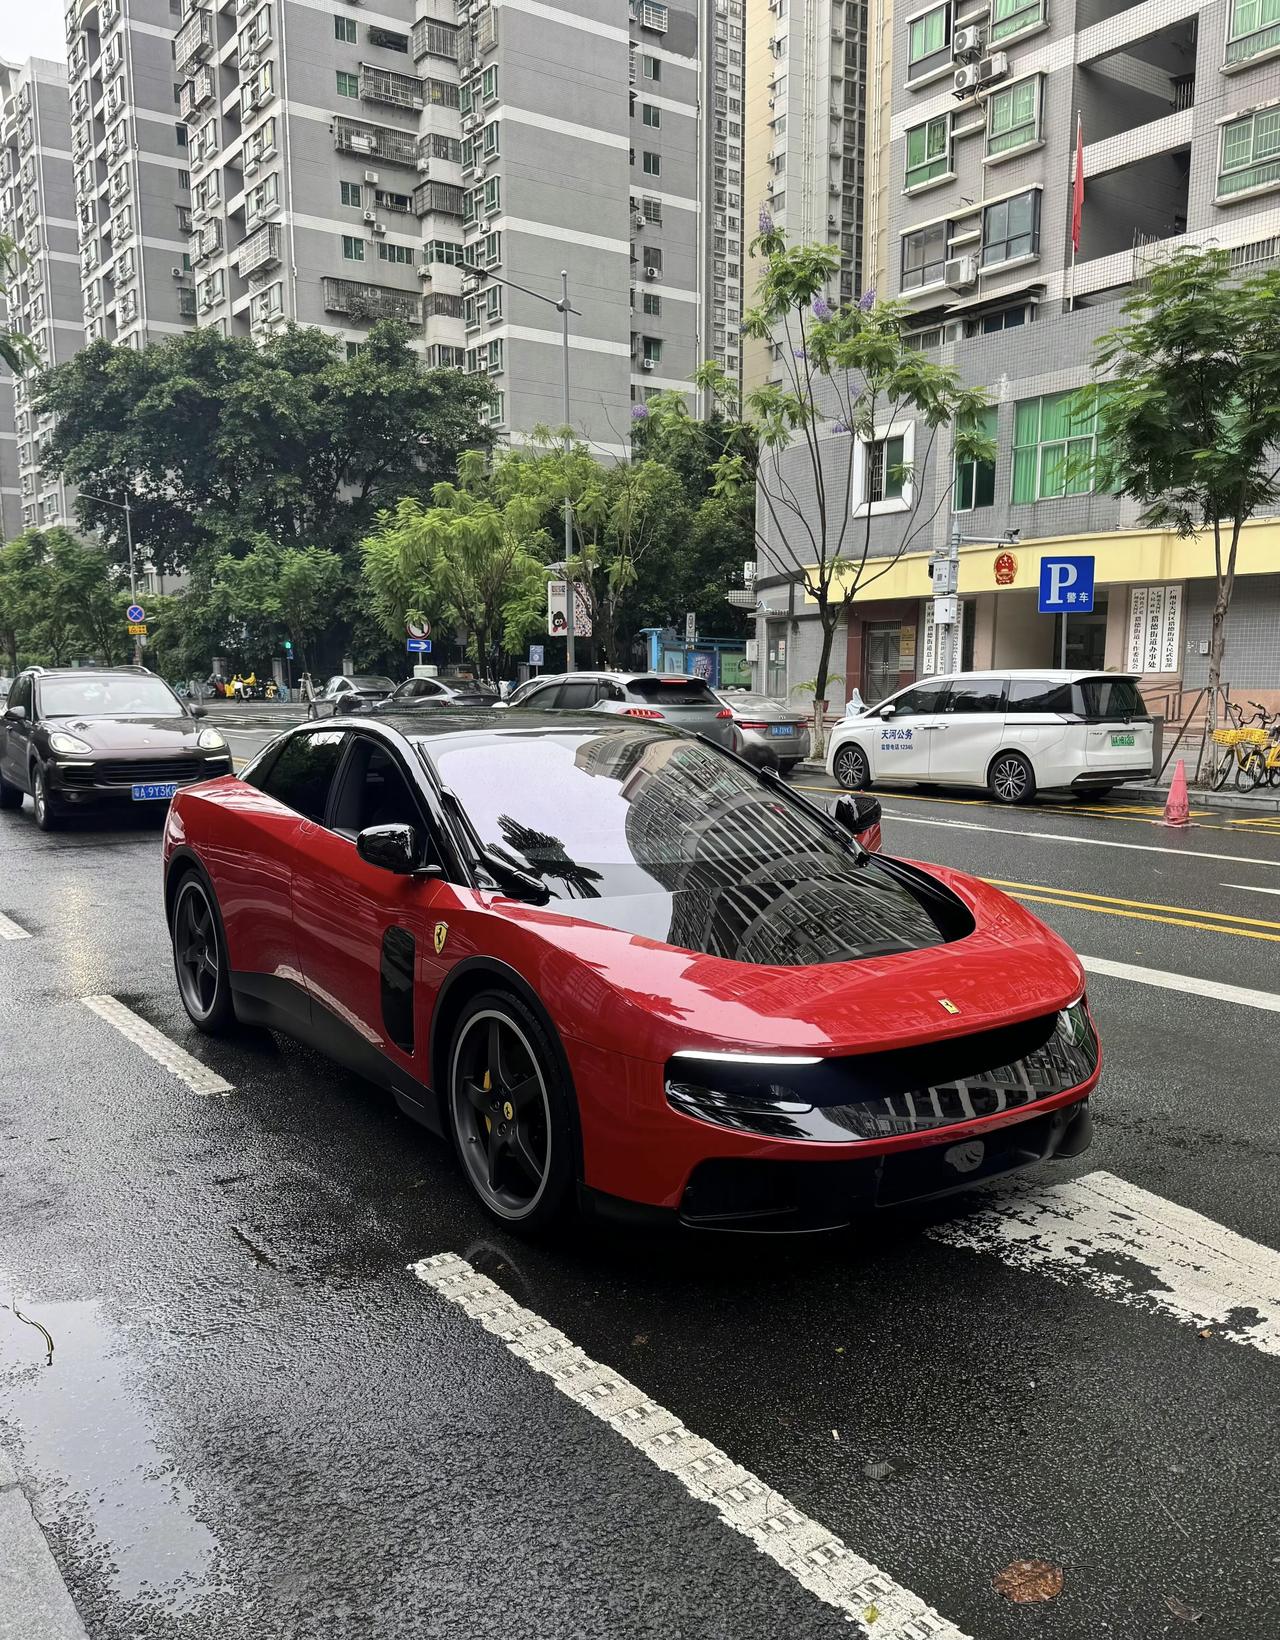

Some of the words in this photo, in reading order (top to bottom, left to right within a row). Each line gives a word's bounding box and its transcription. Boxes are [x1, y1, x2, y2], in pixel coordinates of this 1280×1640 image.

[1046, 563, 1078, 604] P
[1066, 592, 1089, 603] 警车
[1148, 615, 1159, 669] 猎德街道办事处
[881, 729, 912, 740] 天河公务
